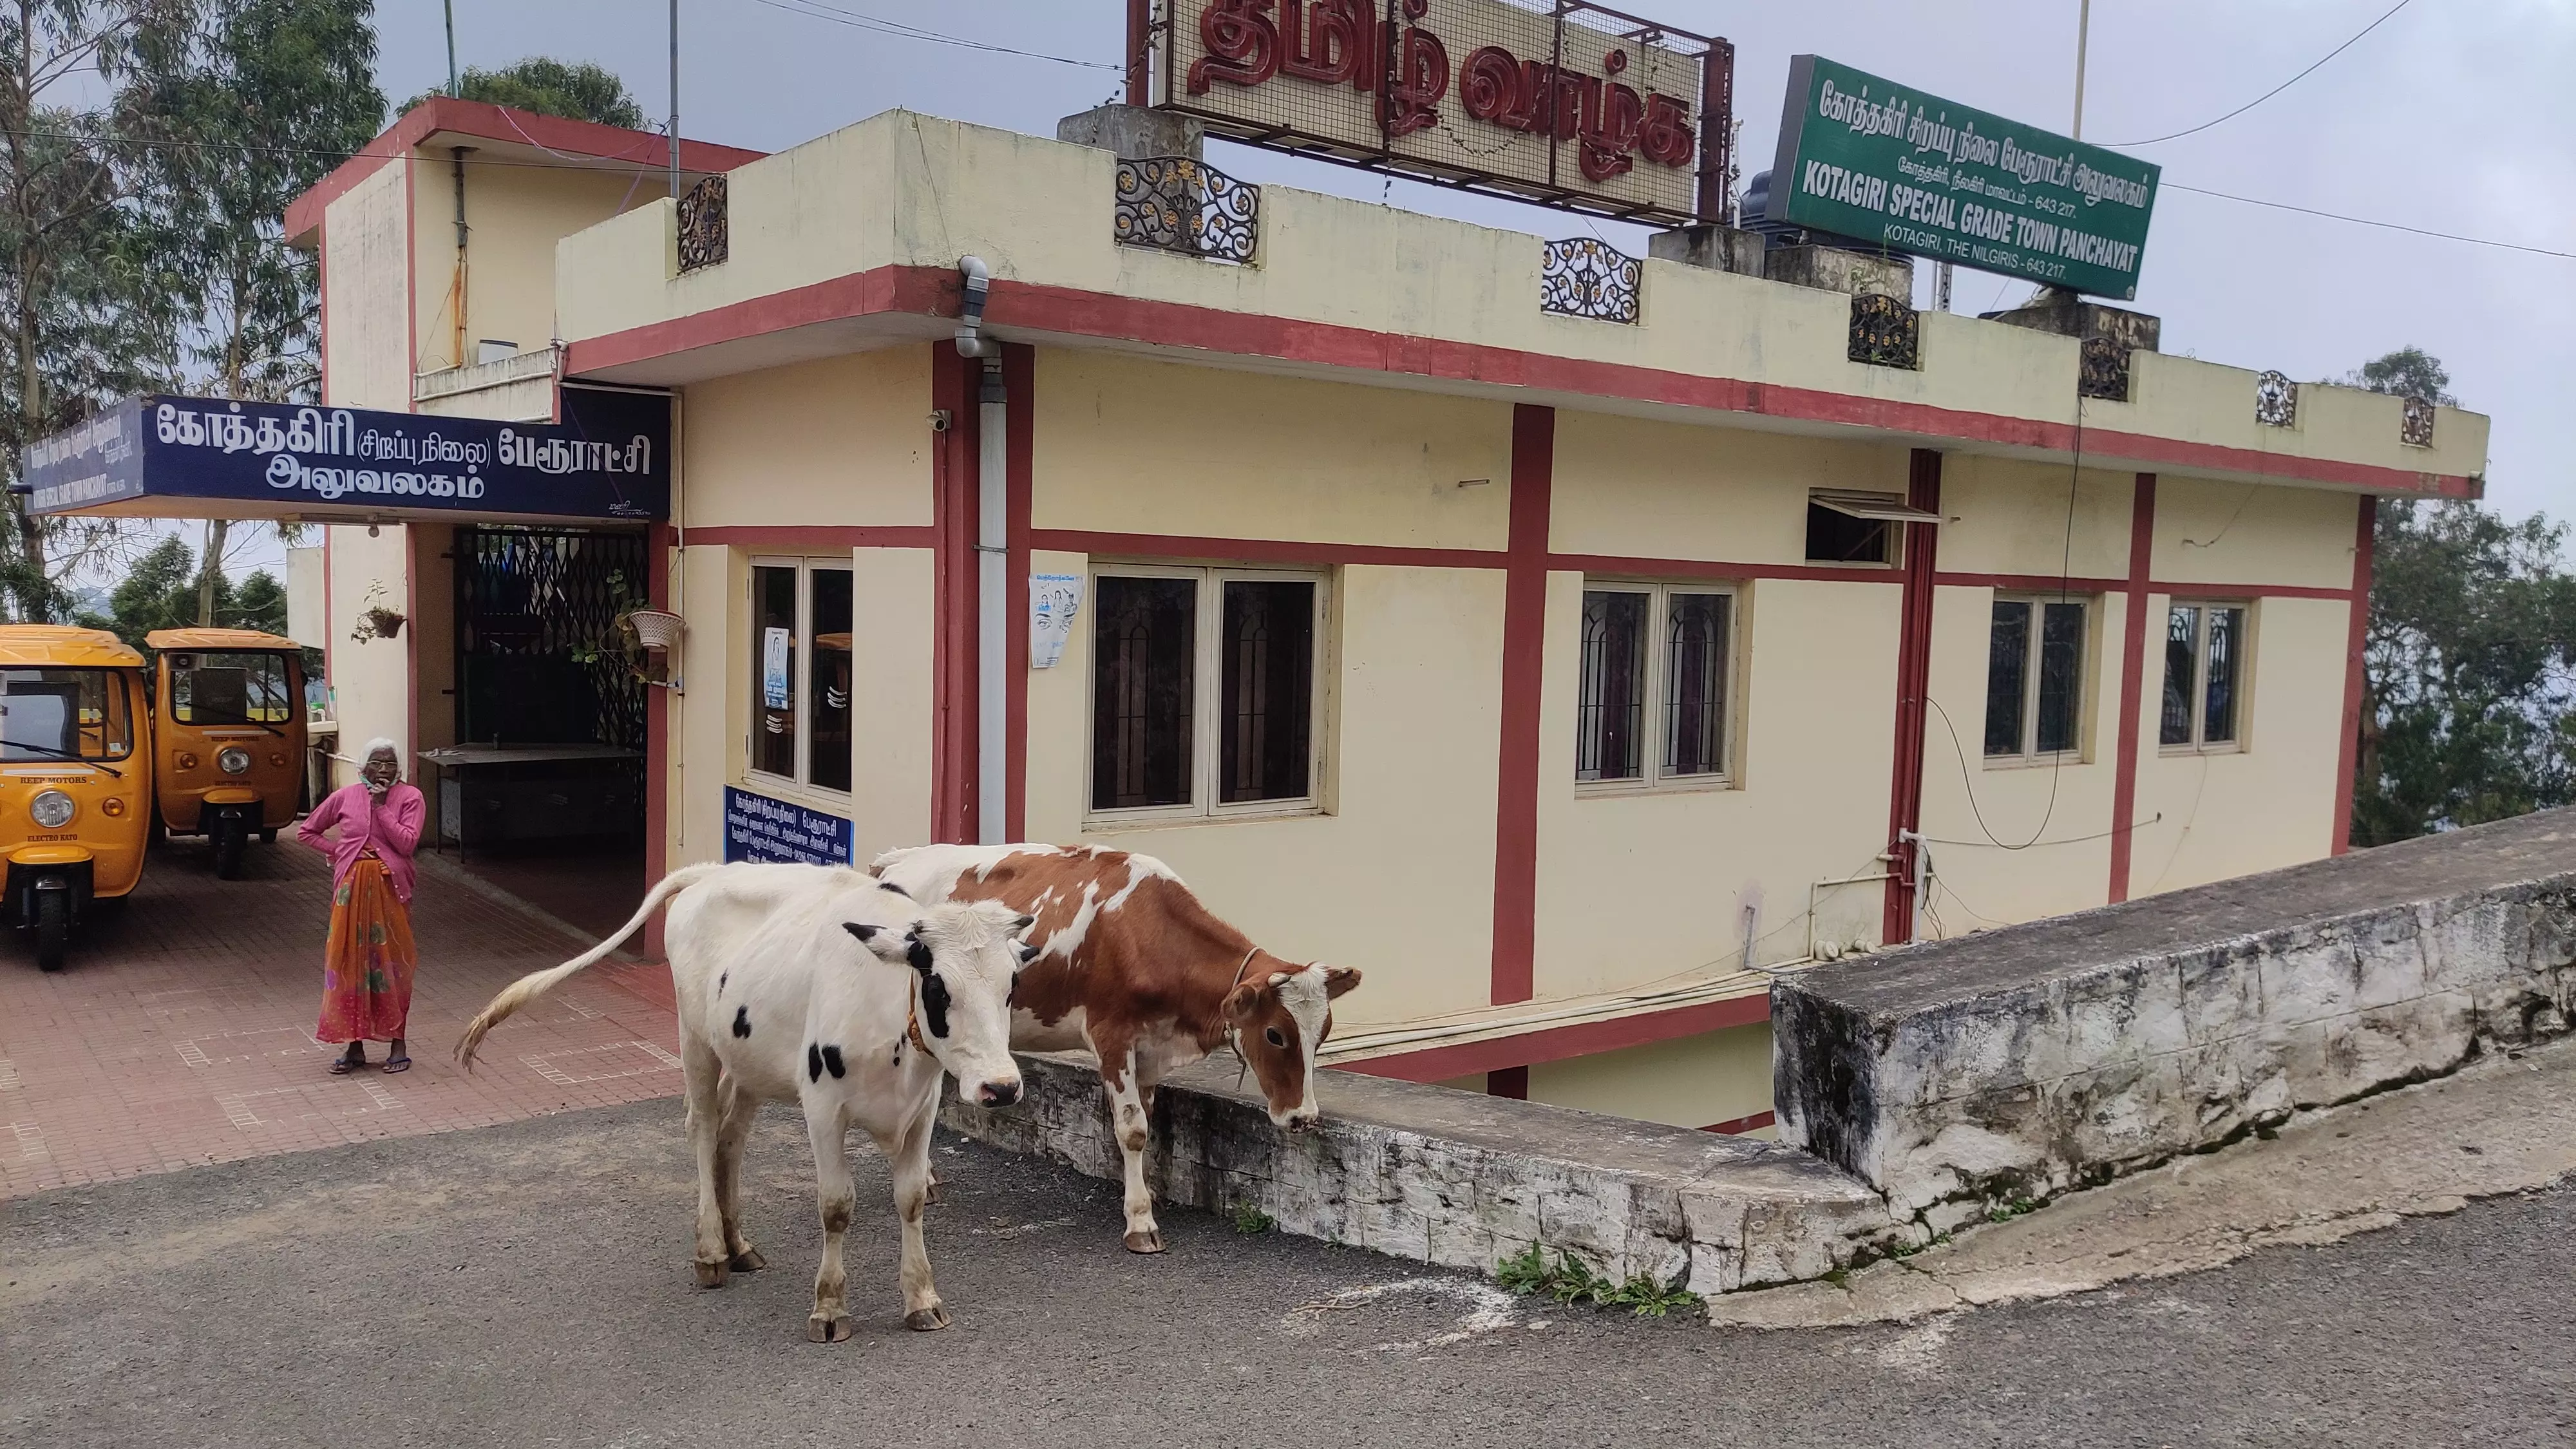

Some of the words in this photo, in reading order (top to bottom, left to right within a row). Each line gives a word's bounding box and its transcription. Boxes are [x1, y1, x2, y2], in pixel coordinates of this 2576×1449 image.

[1459, 46, 1696, 184] வாழ்க
[1819, 79, 1908, 140] கோத்தகிரி
[1906, 105, 1957, 163] சிறப்பு
[1953, 121, 1999, 167] நிலை
[2000, 137, 2074, 188] பேரூராட்சி
[2072, 163, 2148, 209] அலுவலகம்
[1802, 159, 1889, 213] KOTAGIRI
[1889, 183, 1956, 231] SPECIAL
[1960, 203, 2015, 244] GRADE
[2016, 216, 2059, 255] TOWN
[2058, 227, 2139, 273] PANCHAYAT
[2034, 195, 2056, 214] 643
[1884, 223, 1942, 253] KOTAGIRI,
[1947, 238, 1971, 258] THE
[1971, 243, 2020, 269] NILGIRIS
[2027, 258, 2045, 274] 643
[156, 402, 355, 456] கோத்தகிரி
[357, 429, 416, 466] (சிறப்பு
[417, 431, 491, 469] நிலை)
[498, 428, 650, 475] பேரூராட்சி
[265, 453, 485, 500] அலுவலகம்
